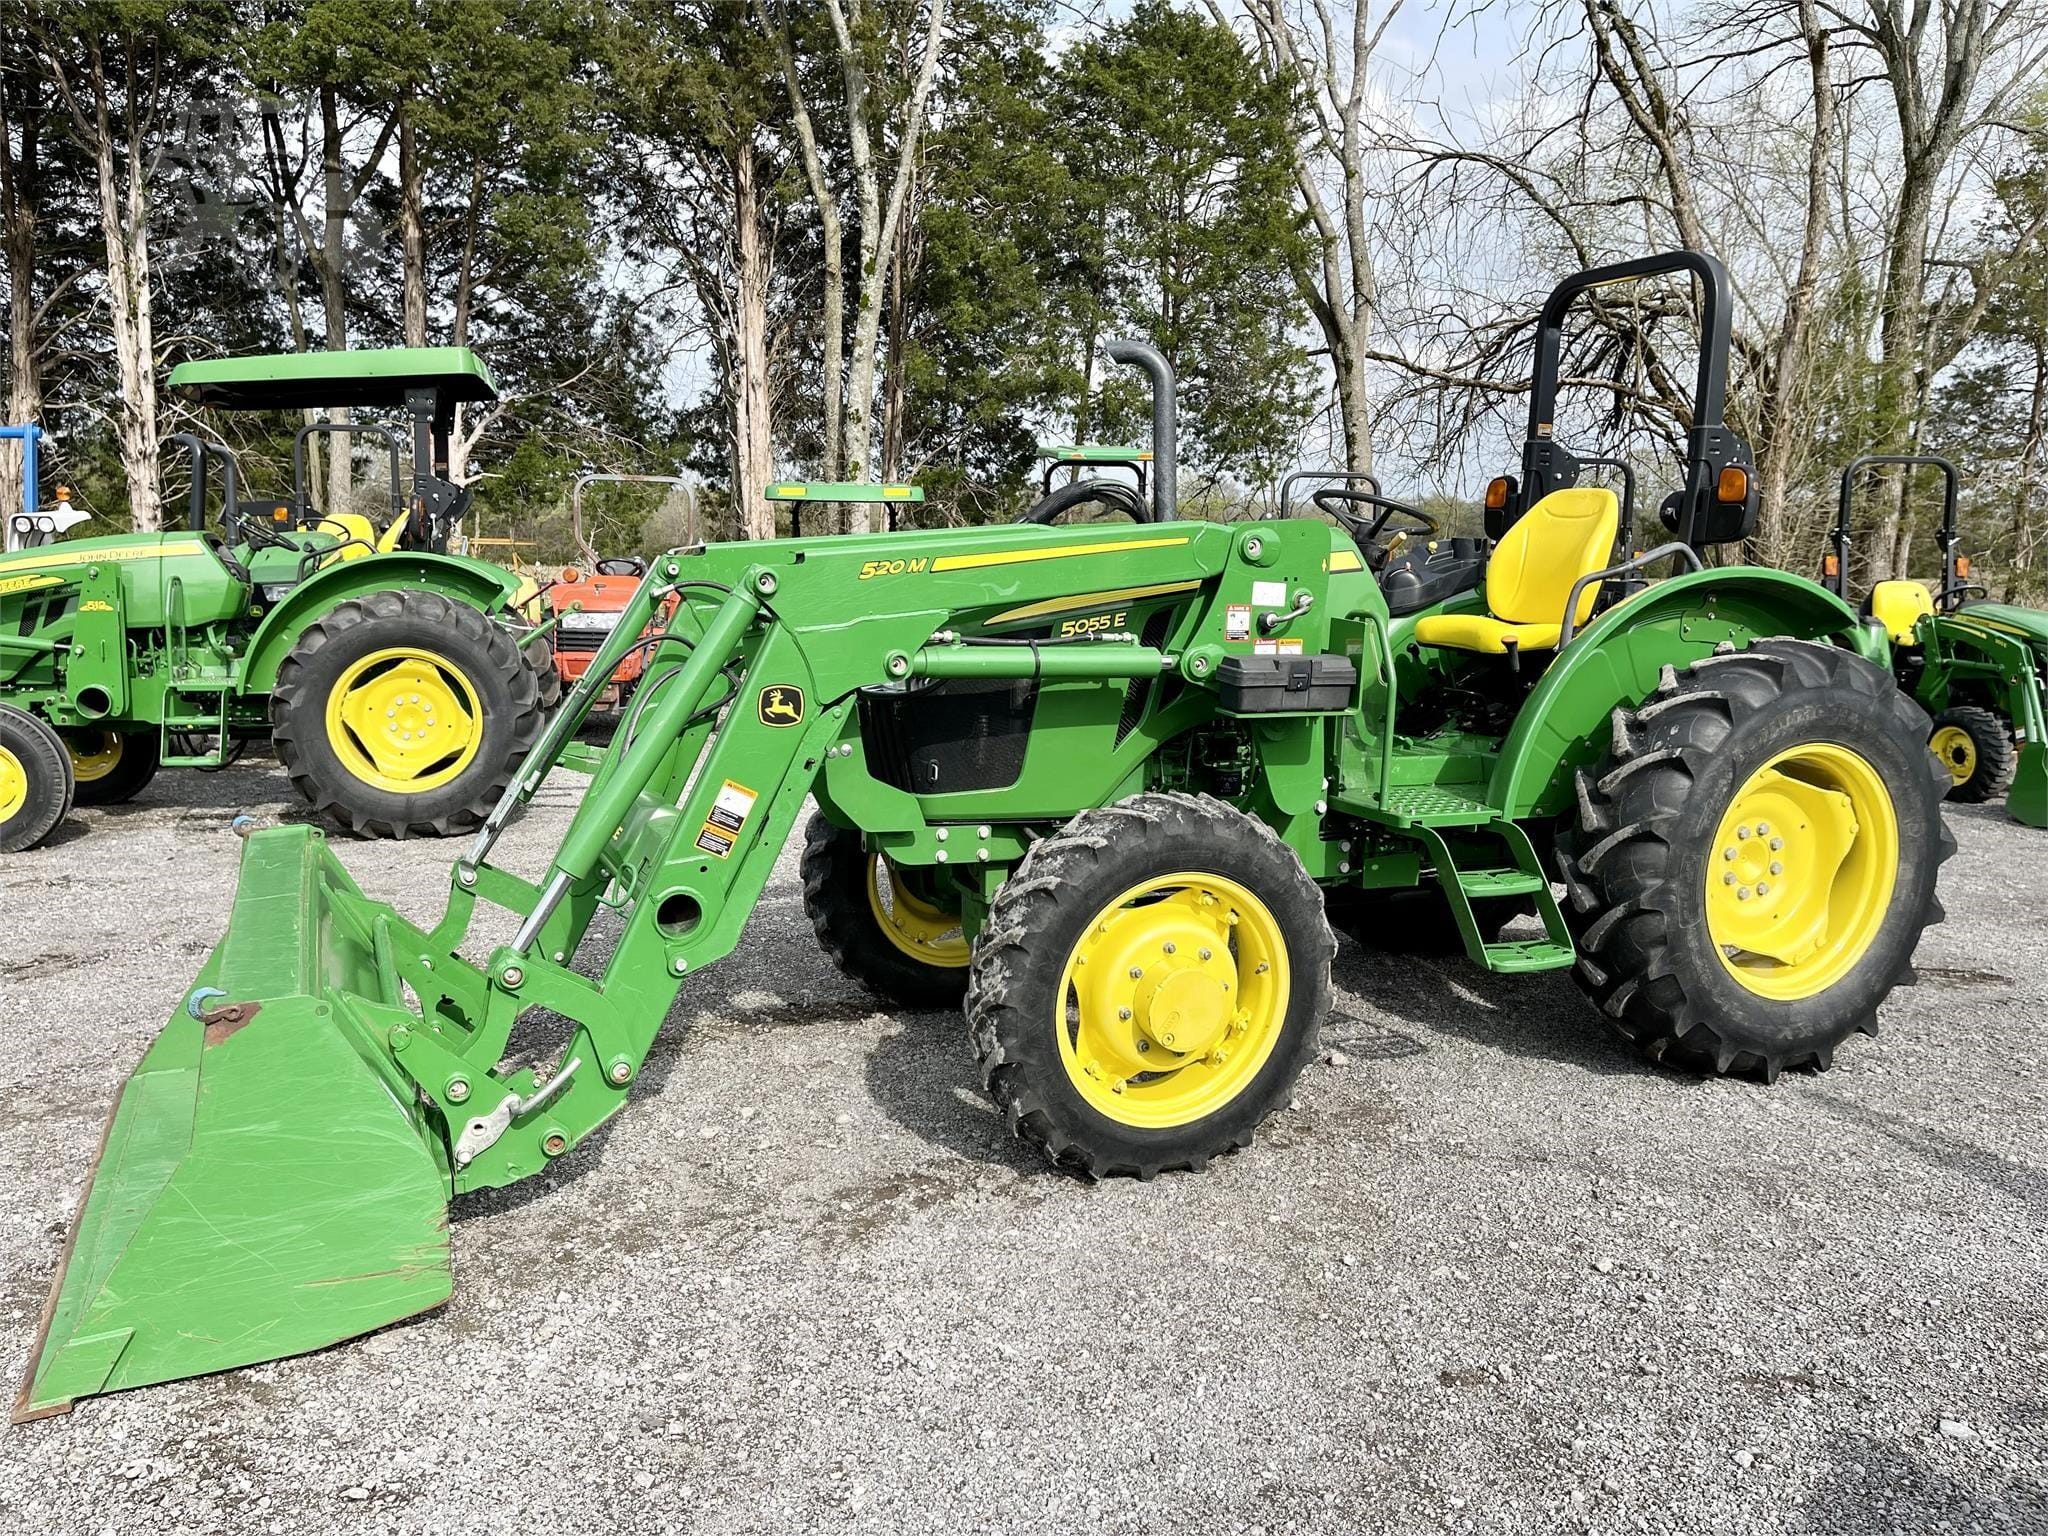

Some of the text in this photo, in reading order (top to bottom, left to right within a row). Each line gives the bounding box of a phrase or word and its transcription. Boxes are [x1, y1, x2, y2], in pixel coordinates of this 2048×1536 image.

[77, 552, 108, 562] JOHN
[858, 557, 929, 580] 520 M
[86, 600, 107, 611] 512
[1060, 612, 1127, 638] 5055 E
